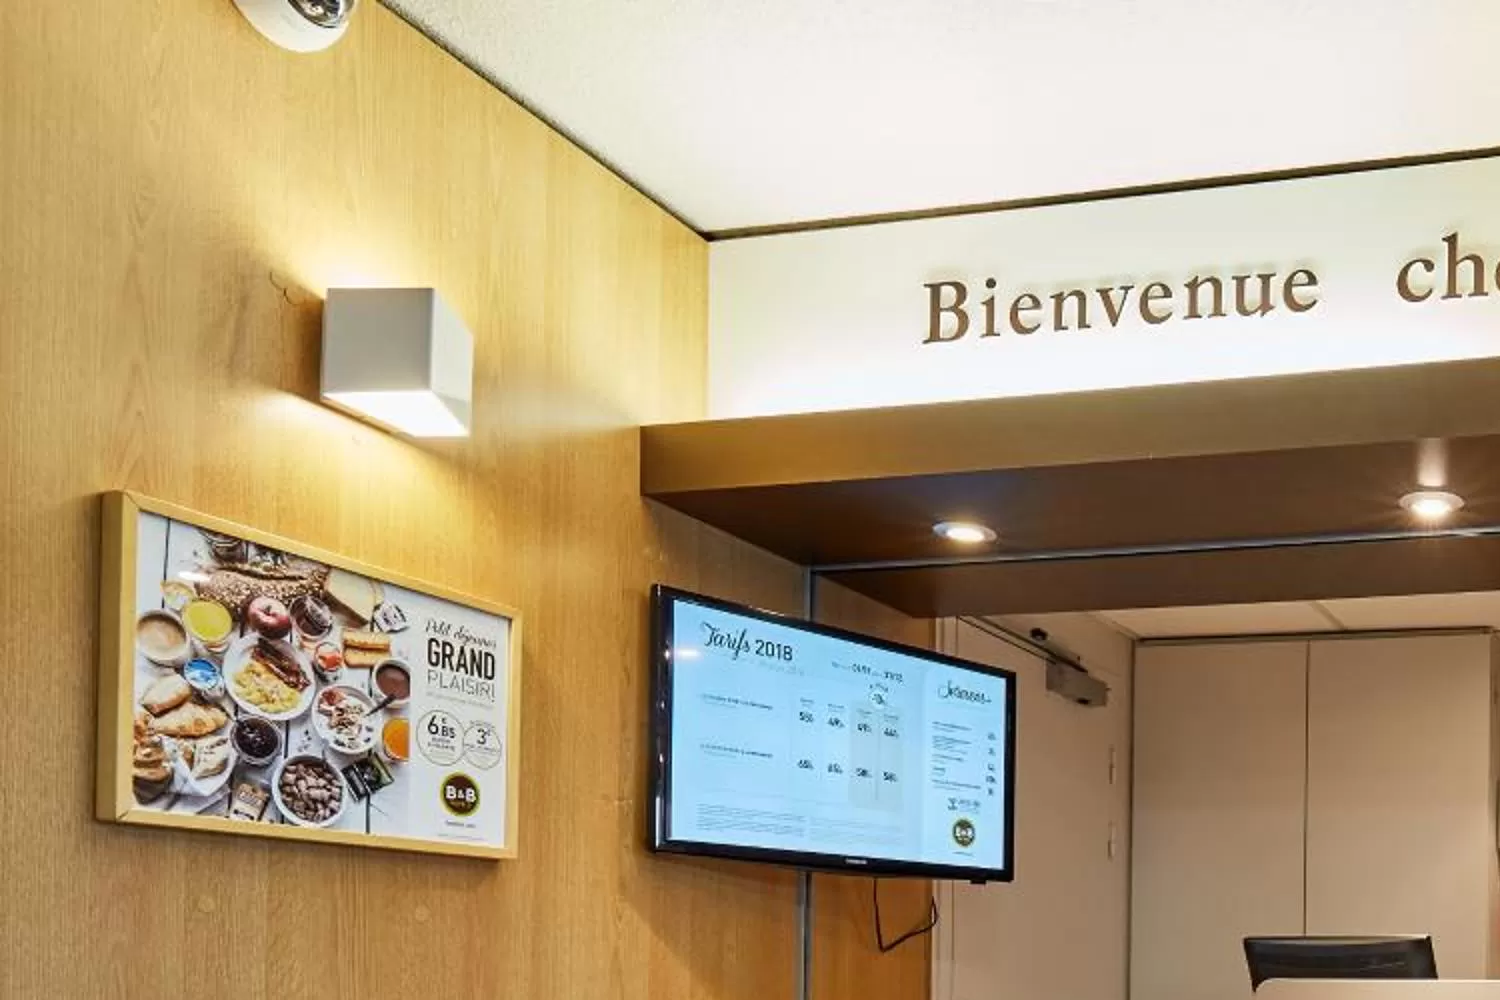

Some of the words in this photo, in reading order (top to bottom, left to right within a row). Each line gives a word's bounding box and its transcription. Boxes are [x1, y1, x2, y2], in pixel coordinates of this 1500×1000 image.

[922, 264, 1320, 345] Bienvenue
[427, 637, 495, 680] GRAND
[702, 621, 751, 660] Tarifs
[755, 639, 793, 661] 2018
[427, 668, 495, 703] PLAISIR!
